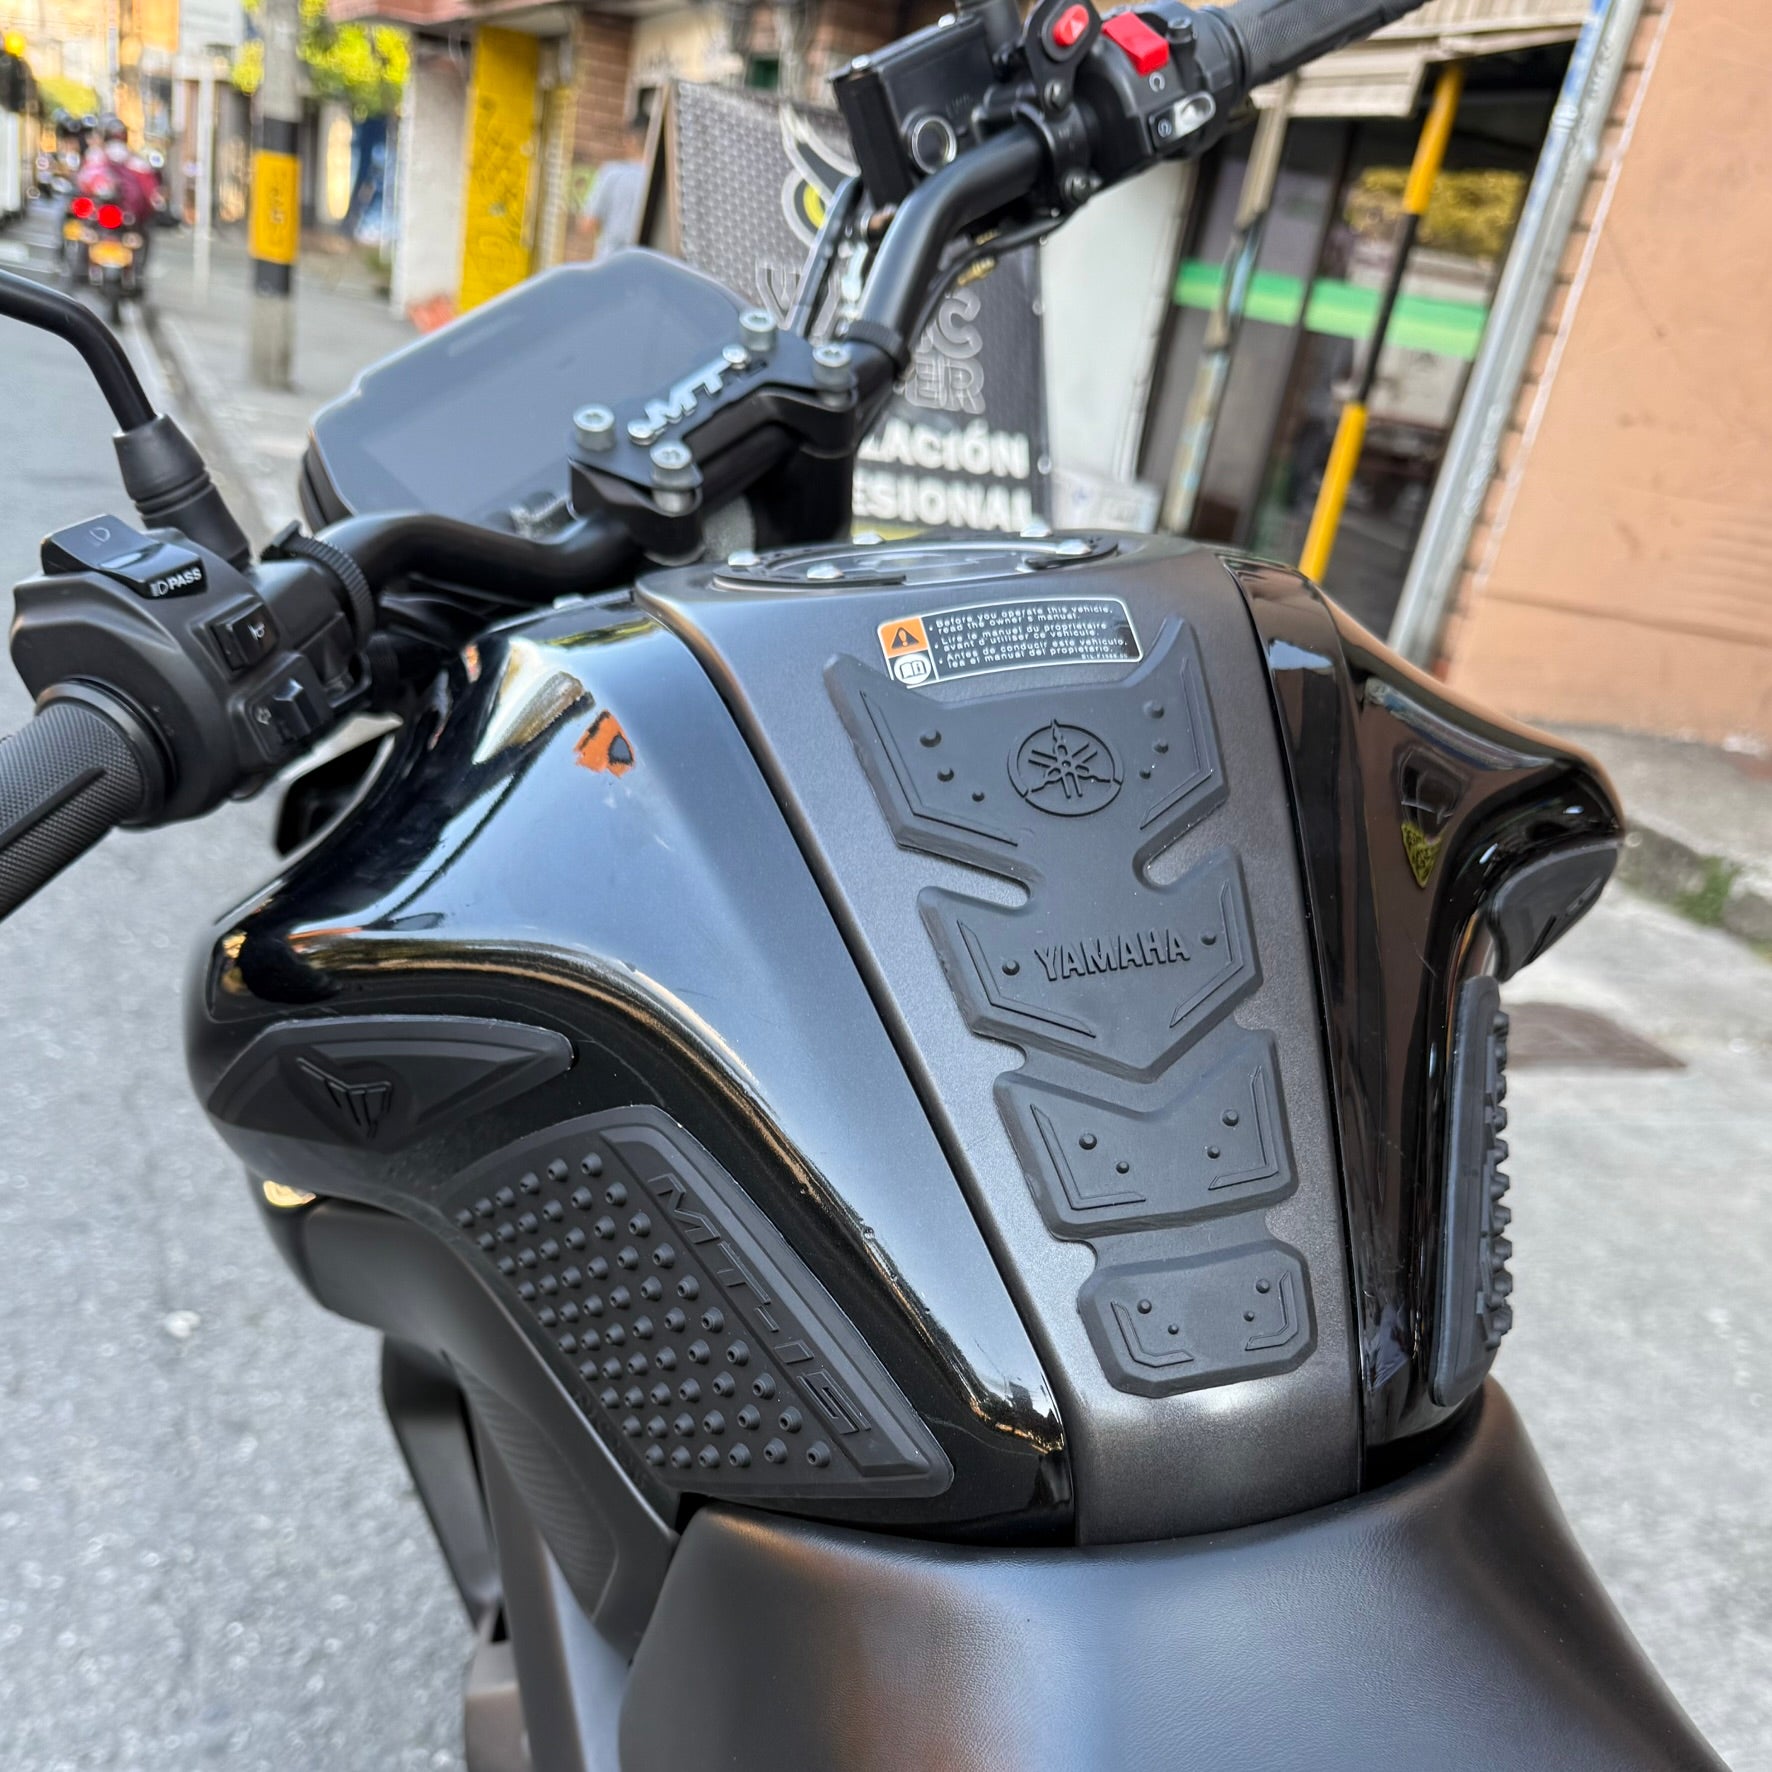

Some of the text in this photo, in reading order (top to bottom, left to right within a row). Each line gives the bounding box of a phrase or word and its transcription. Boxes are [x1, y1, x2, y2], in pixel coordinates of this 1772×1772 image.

[166, 567, 202, 590] PASS
[936, 615, 973, 628] Before
[977, 612, 997, 622] you
[1001, 607, 1043, 618] operate
[1047, 605, 1068, 614] this
[938, 624, 963, 635] read
[967, 621, 985, 630] the
[941, 635, 963, 646] Lire
[967, 632, 978, 640] le
[982, 626, 1022, 638] manuel
[1026, 624, 1040, 633] du
[944, 640, 975, 652] avant
[1034, 632, 1046, 640] ce
[947, 650, 978, 662] Antes
[983, 647, 996, 656] de
[1001, 641, 1047, 653] conducir
[1052, 638, 1075, 648] este
[948, 659, 966, 669] lea
[970, 656, 980, 665] el
[985, 652, 1025, 663] manual
[1029, 647, 1046, 657] del
[1034, 929, 1191, 982] YAMAHA
[648, 1173, 871, 1434] MT-15
